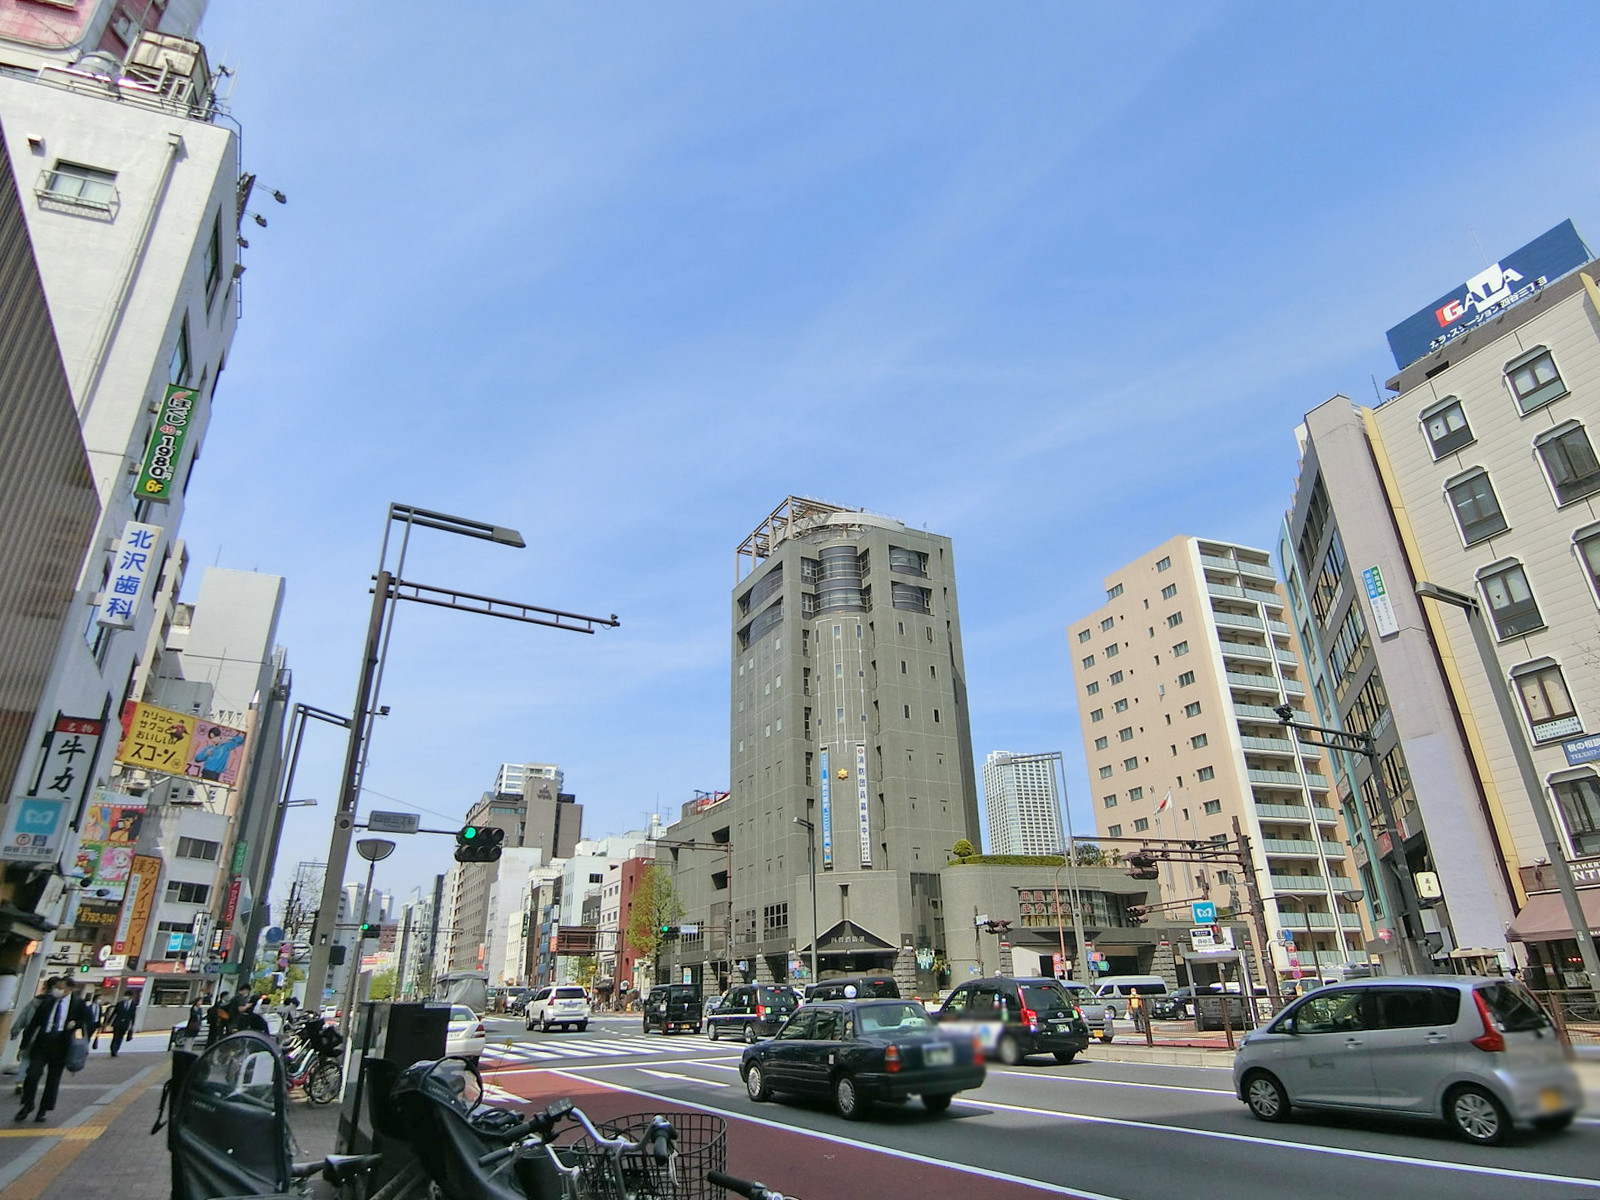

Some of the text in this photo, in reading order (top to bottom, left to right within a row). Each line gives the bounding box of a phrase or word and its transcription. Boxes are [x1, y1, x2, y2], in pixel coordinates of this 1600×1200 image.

[146, 480, 163, 493] 6F
[106, 530, 155, 620] 北沢歯科
[66, 722, 94, 734] 名物
[131, 742, 177, 765] スコーン
[129, 877, 154, 953] ダイエット
